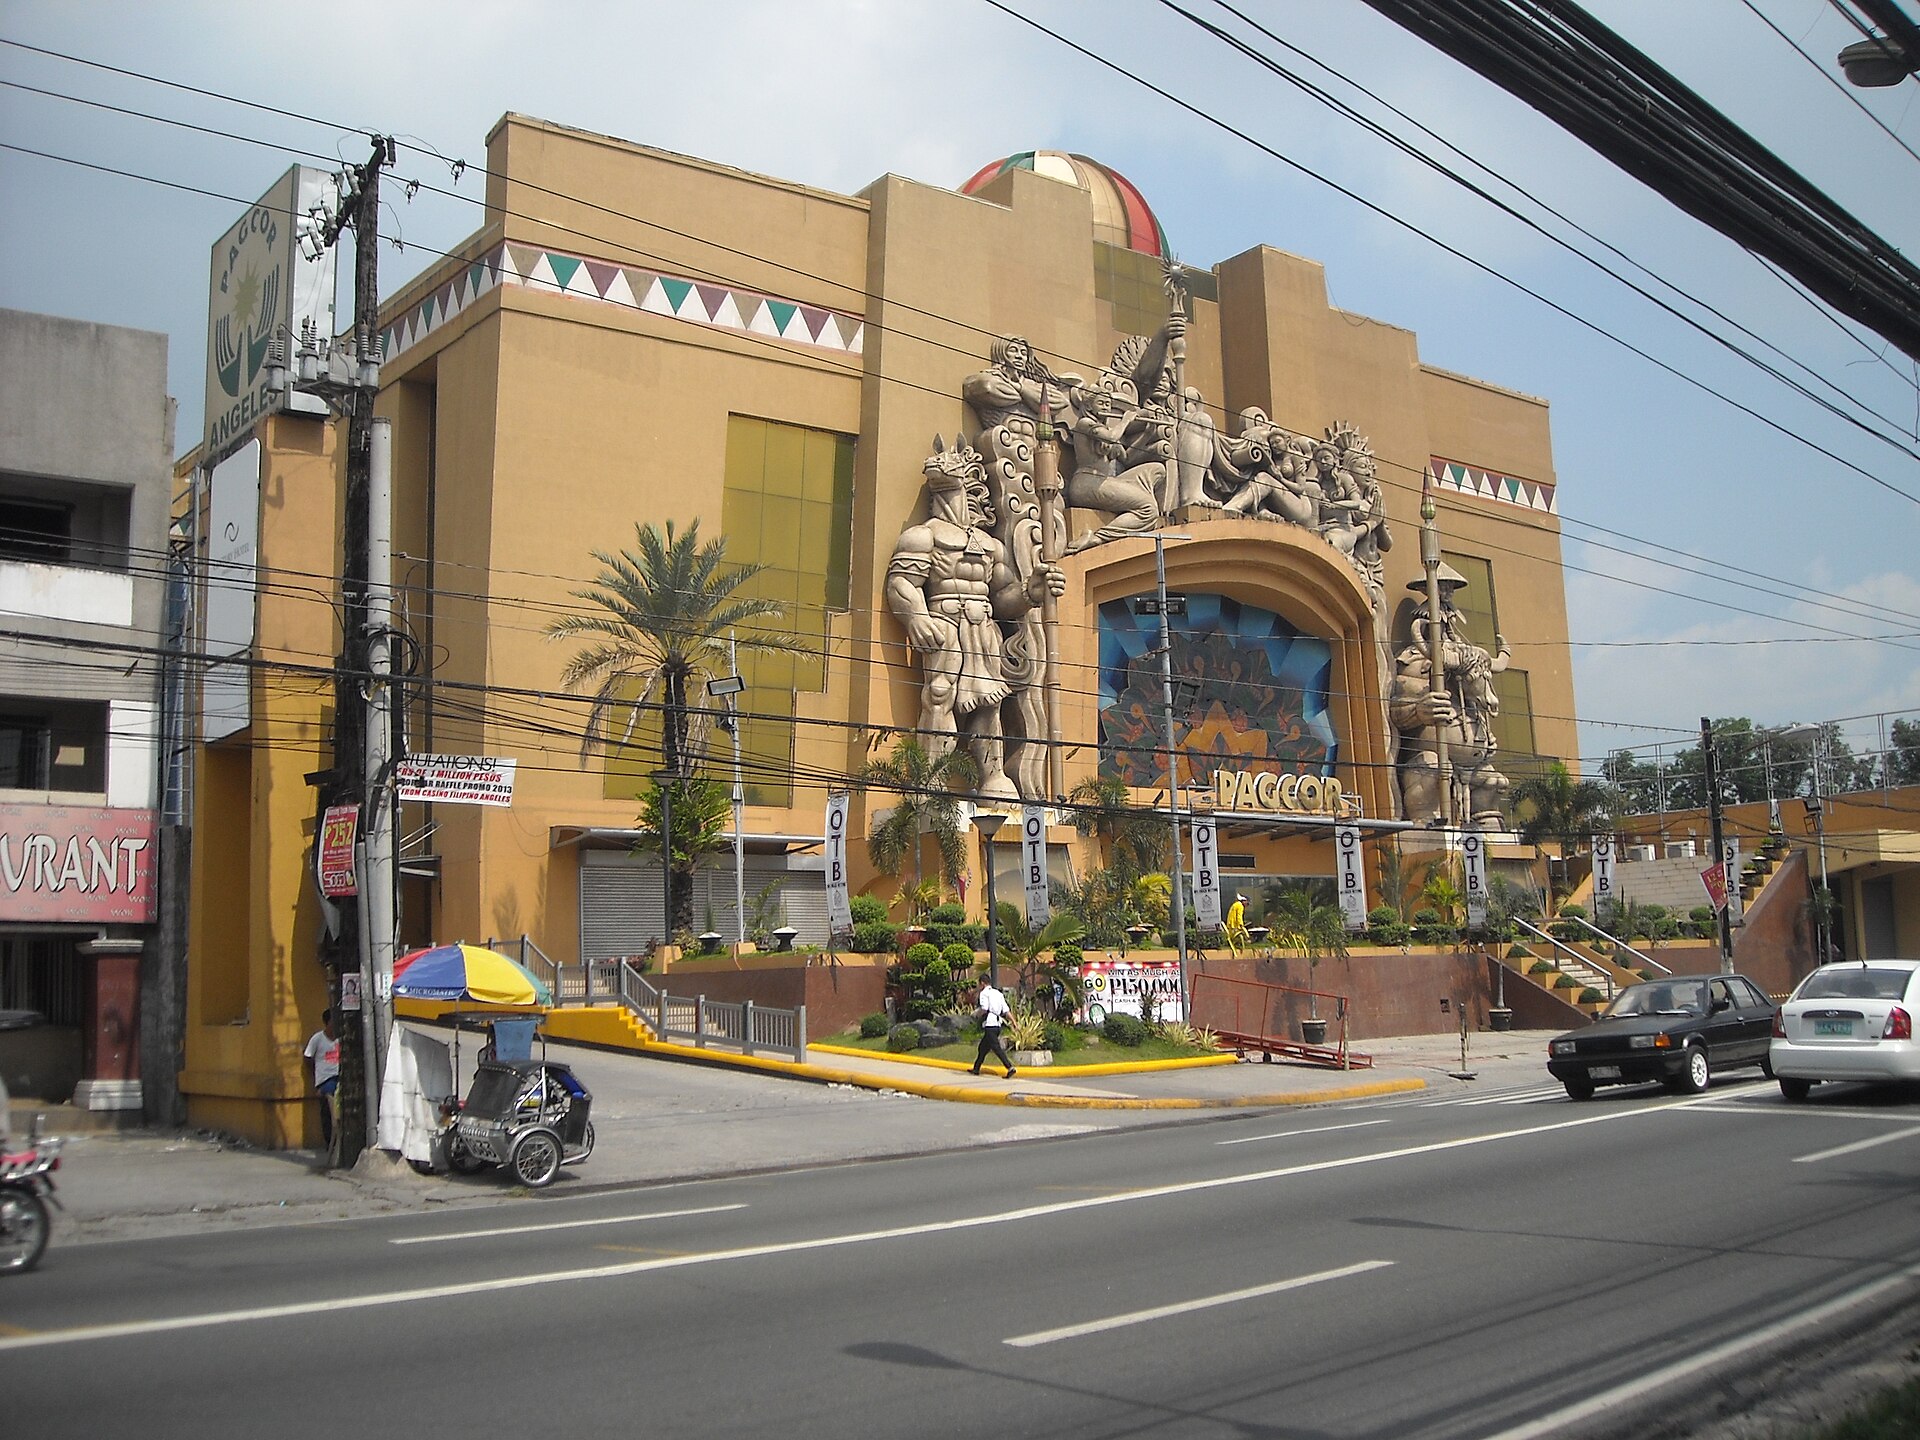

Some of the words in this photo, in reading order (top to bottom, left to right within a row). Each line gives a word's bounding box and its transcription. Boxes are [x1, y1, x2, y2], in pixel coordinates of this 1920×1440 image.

[220, 208, 278, 294] PAGCOR
[401, 788, 421, 796] FROM
[421, 789, 448, 798] CASINO
[449, 791, 479, 800] FILIPINO
[480, 793, 511, 803] ANGELES
[435, 781, 461, 789] RAFFLE
[462, 782, 491, 791] PROMO
[492, 784, 513, 794] 2013
[437, 770, 471, 781] MILLION
[473, 772, 502, 783] PESOS
[1214, 769, 1344, 812] PAGCOR
[829, 809, 843, 882] OTB
[1026, 817, 1041, 884] OTB
[1196, 825, 1212, 888] OTB
[1340, 831, 1356, 889] OTB
[1465, 836, 1479, 890] OTB
